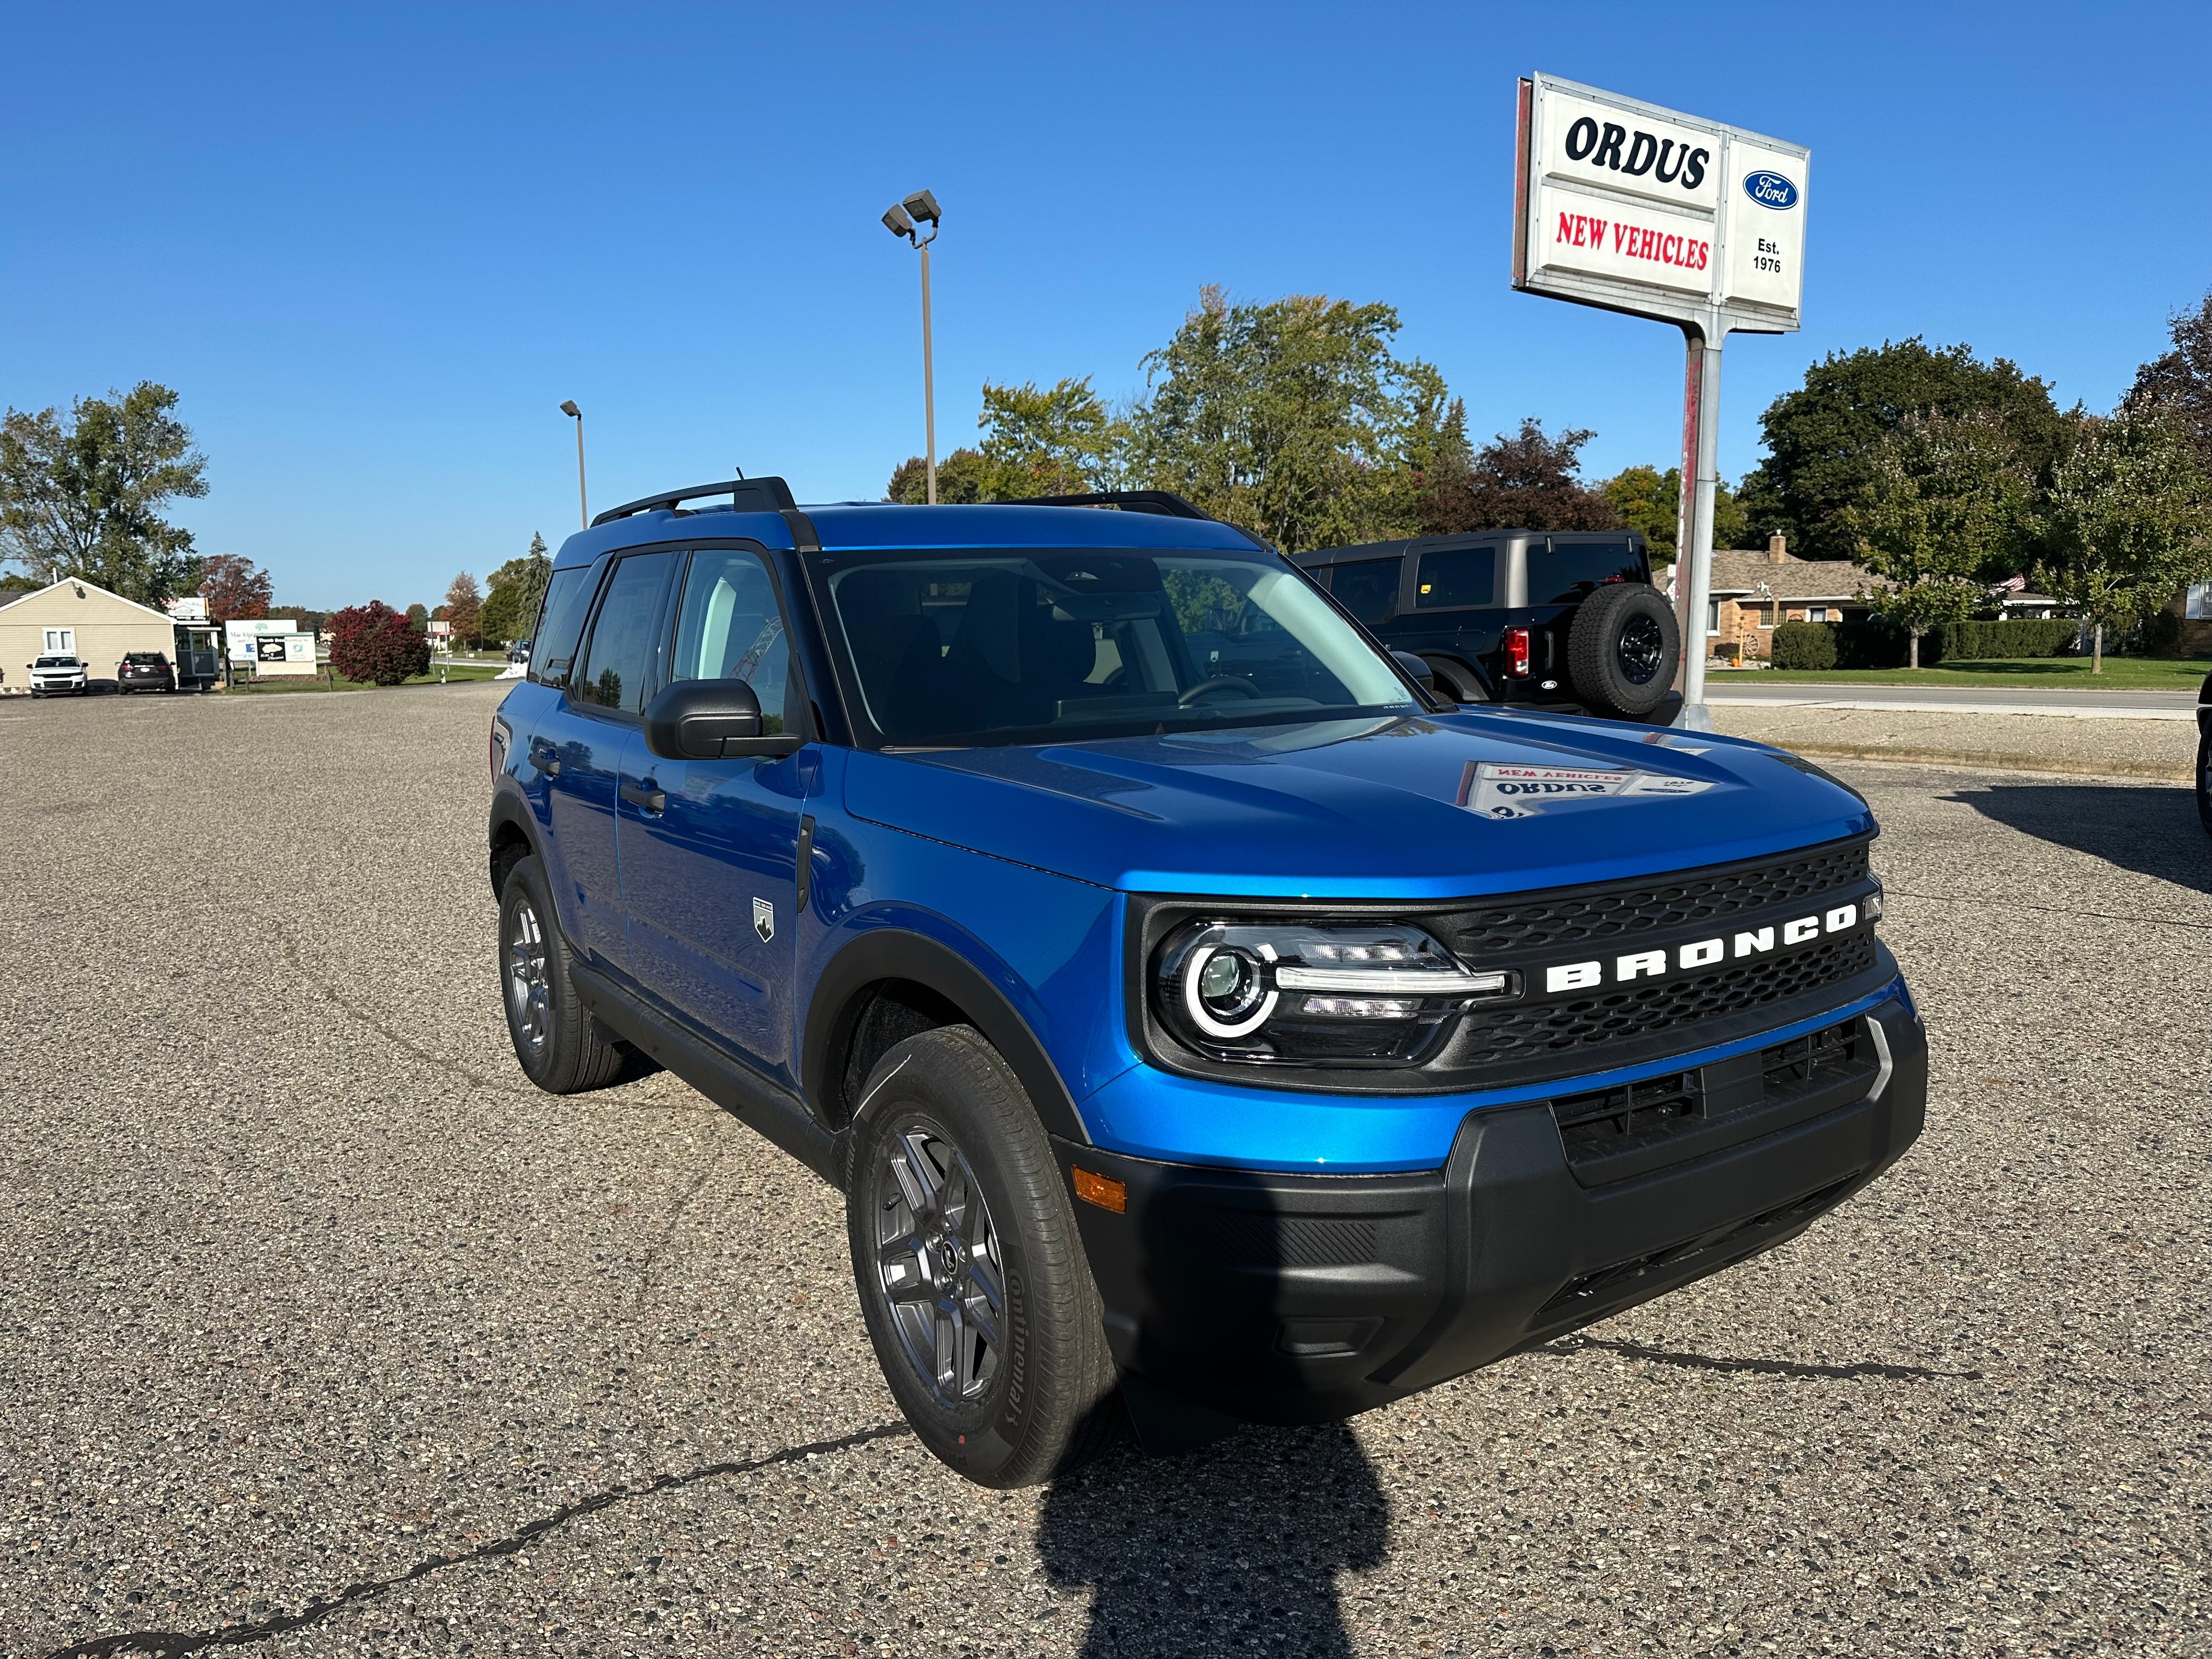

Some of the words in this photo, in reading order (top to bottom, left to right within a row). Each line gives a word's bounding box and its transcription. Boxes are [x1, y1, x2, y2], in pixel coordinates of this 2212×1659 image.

[1565, 117, 1709, 190] ORDUS
[1754, 174, 1789, 205] Ford
[1556, 212, 1608, 250] NEW
[1614, 223, 1709, 270] VEHICLES
[1753, 255, 1781, 273] 1976
[1758, 238, 1780, 255] Est.
[1547, 904, 1857, 993] BRONCO
[1008, 1268, 1027, 1415] Continental
